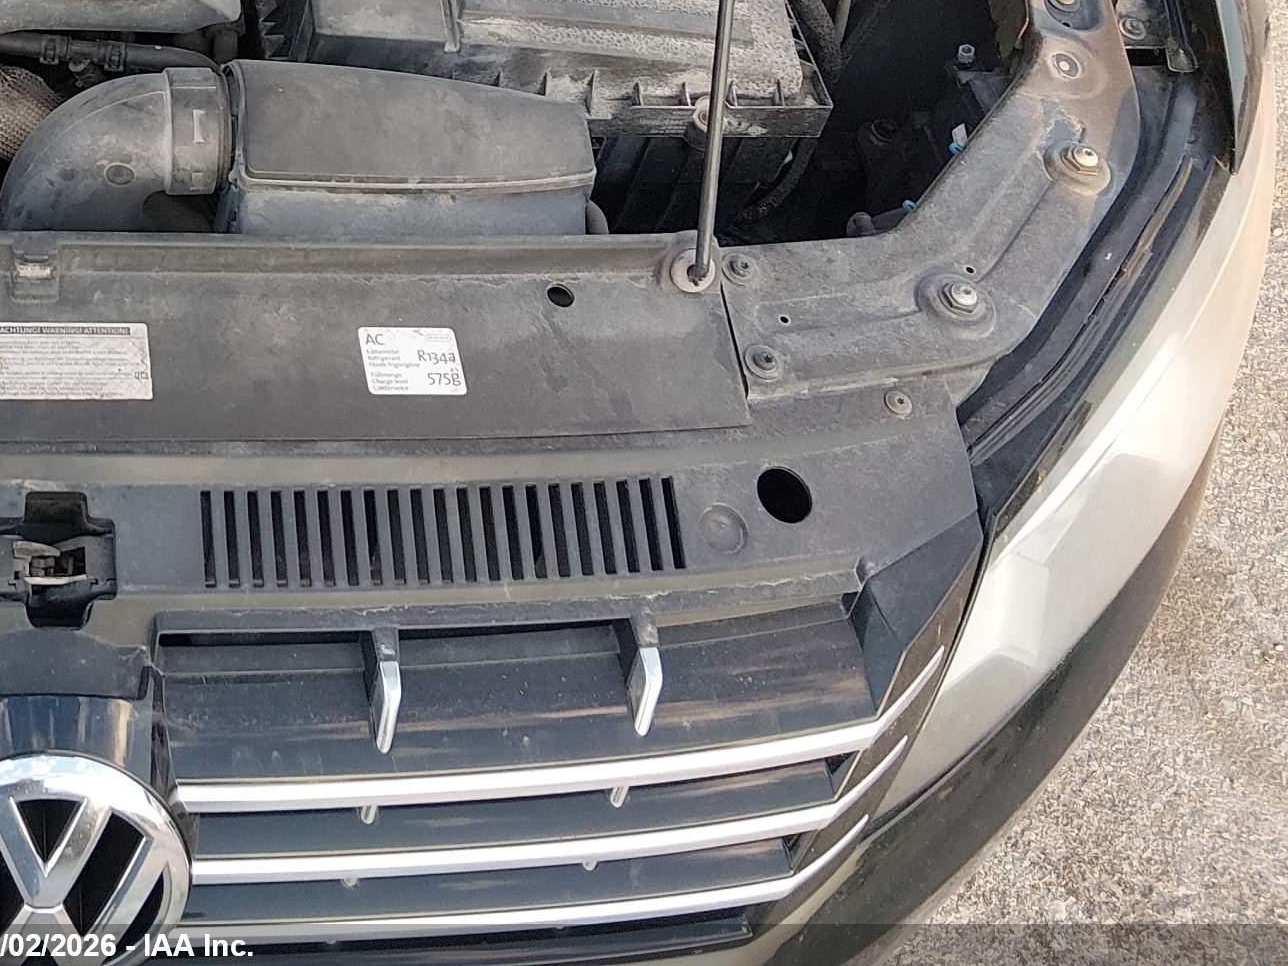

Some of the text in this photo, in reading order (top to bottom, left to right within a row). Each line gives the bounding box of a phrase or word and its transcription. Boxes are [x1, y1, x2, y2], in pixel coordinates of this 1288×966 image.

[0, 327, 129, 335] ACHTUNG! WARNING! ATTENTION!
[365, 334, 385, 346] AC
[417, 350, 457, 365] R134a
[427, 372, 462, 387] 575g
